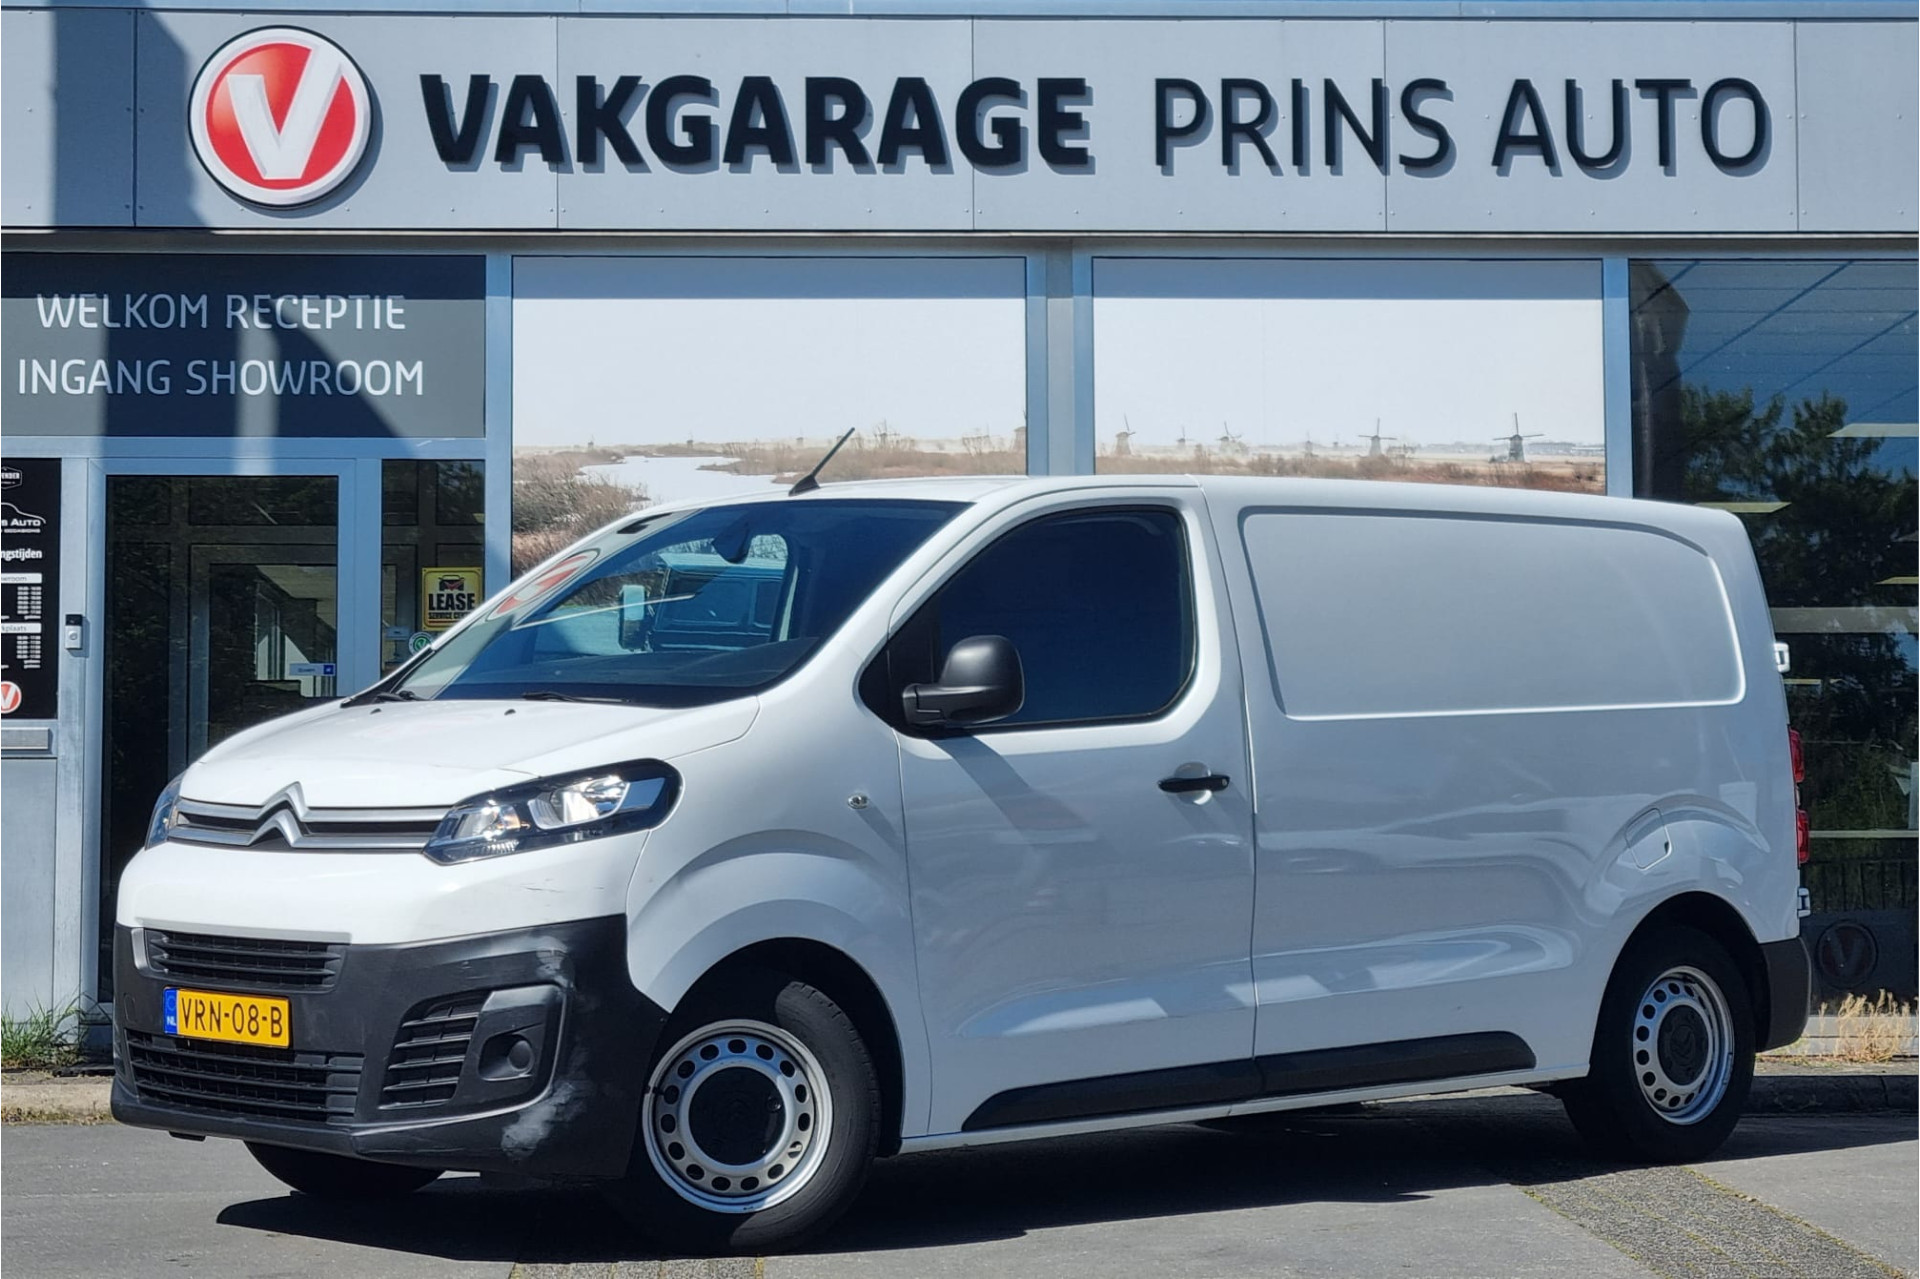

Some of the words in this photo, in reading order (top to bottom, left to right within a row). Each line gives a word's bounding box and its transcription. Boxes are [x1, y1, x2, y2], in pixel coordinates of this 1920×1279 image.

[419, 74, 1089, 167] VAKGARAGE
[1154, 77, 1451, 168] PRINS
[1491, 77, 1767, 168] AUTO
[36, 293, 209, 330] WELKOM
[225, 293, 406, 330] RECEPTIE
[18, 358, 171, 396] INGANG
[186, 359, 424, 396] SHOWROOM
[428, 593, 475, 610] LEASE
[166, 1016, 177, 1026] NL
[181, 997, 283, 1038] VRN-08-B
